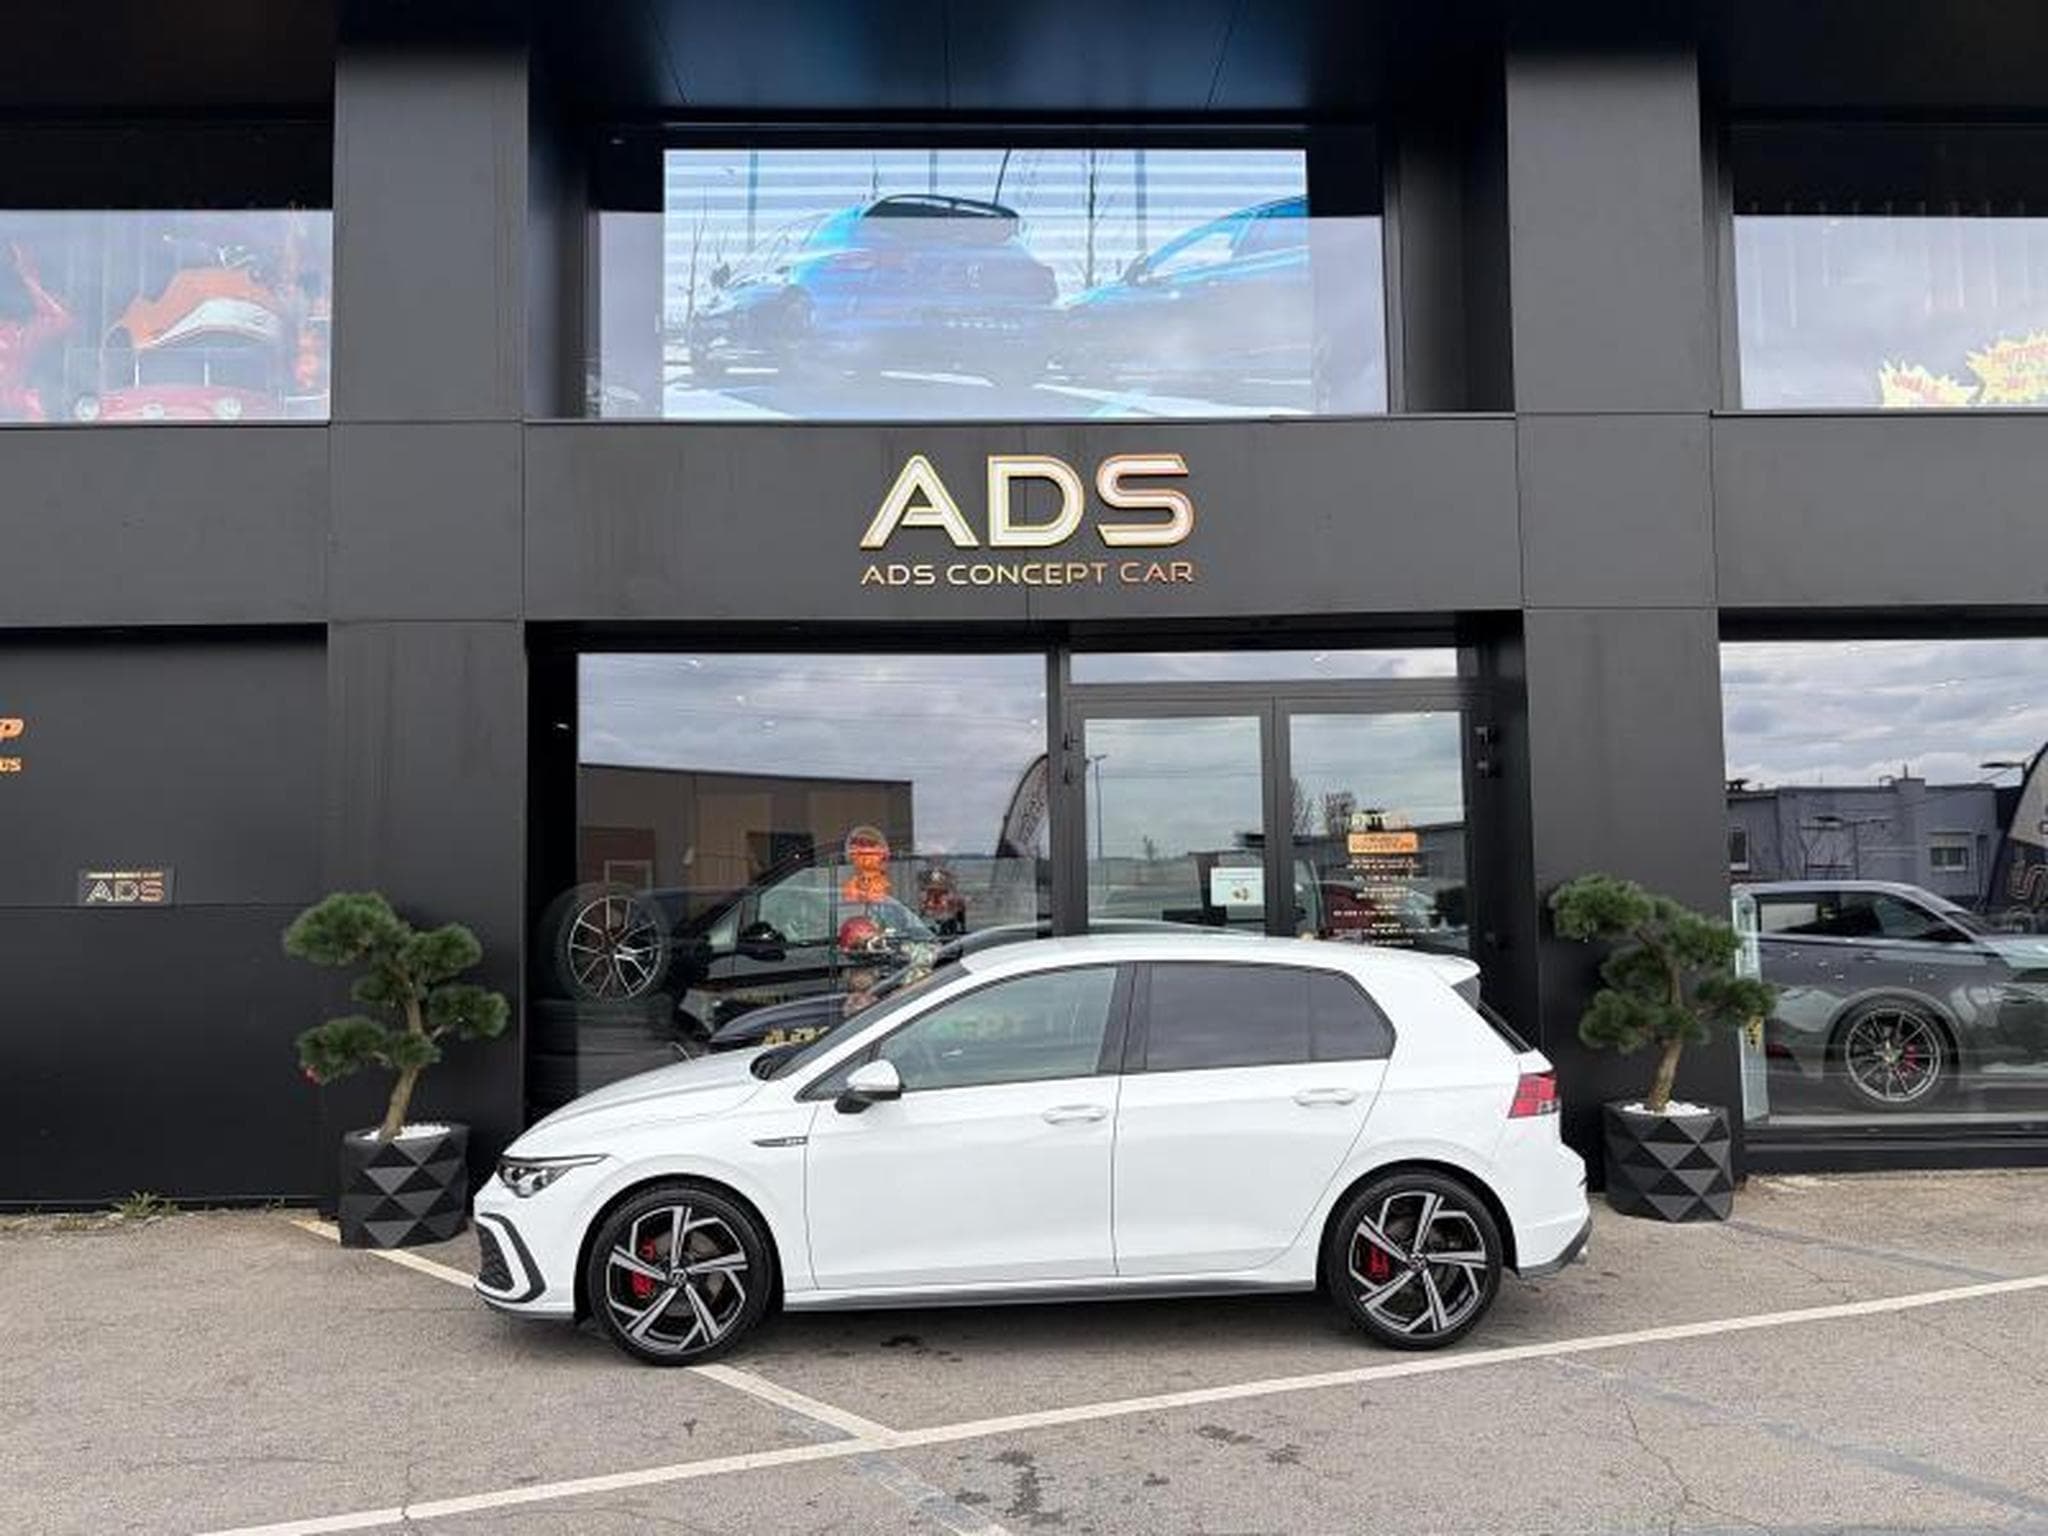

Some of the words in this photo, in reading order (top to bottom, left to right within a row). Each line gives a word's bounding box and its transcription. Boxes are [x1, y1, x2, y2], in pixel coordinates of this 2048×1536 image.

[860, 454, 1194, 548] ADS
[861, 564, 936, 586] ADS
[946, 562, 1108, 586] CONCEPT
[1119, 561, 1195, 584] CAR
[86, 879, 164, 902] ADS
